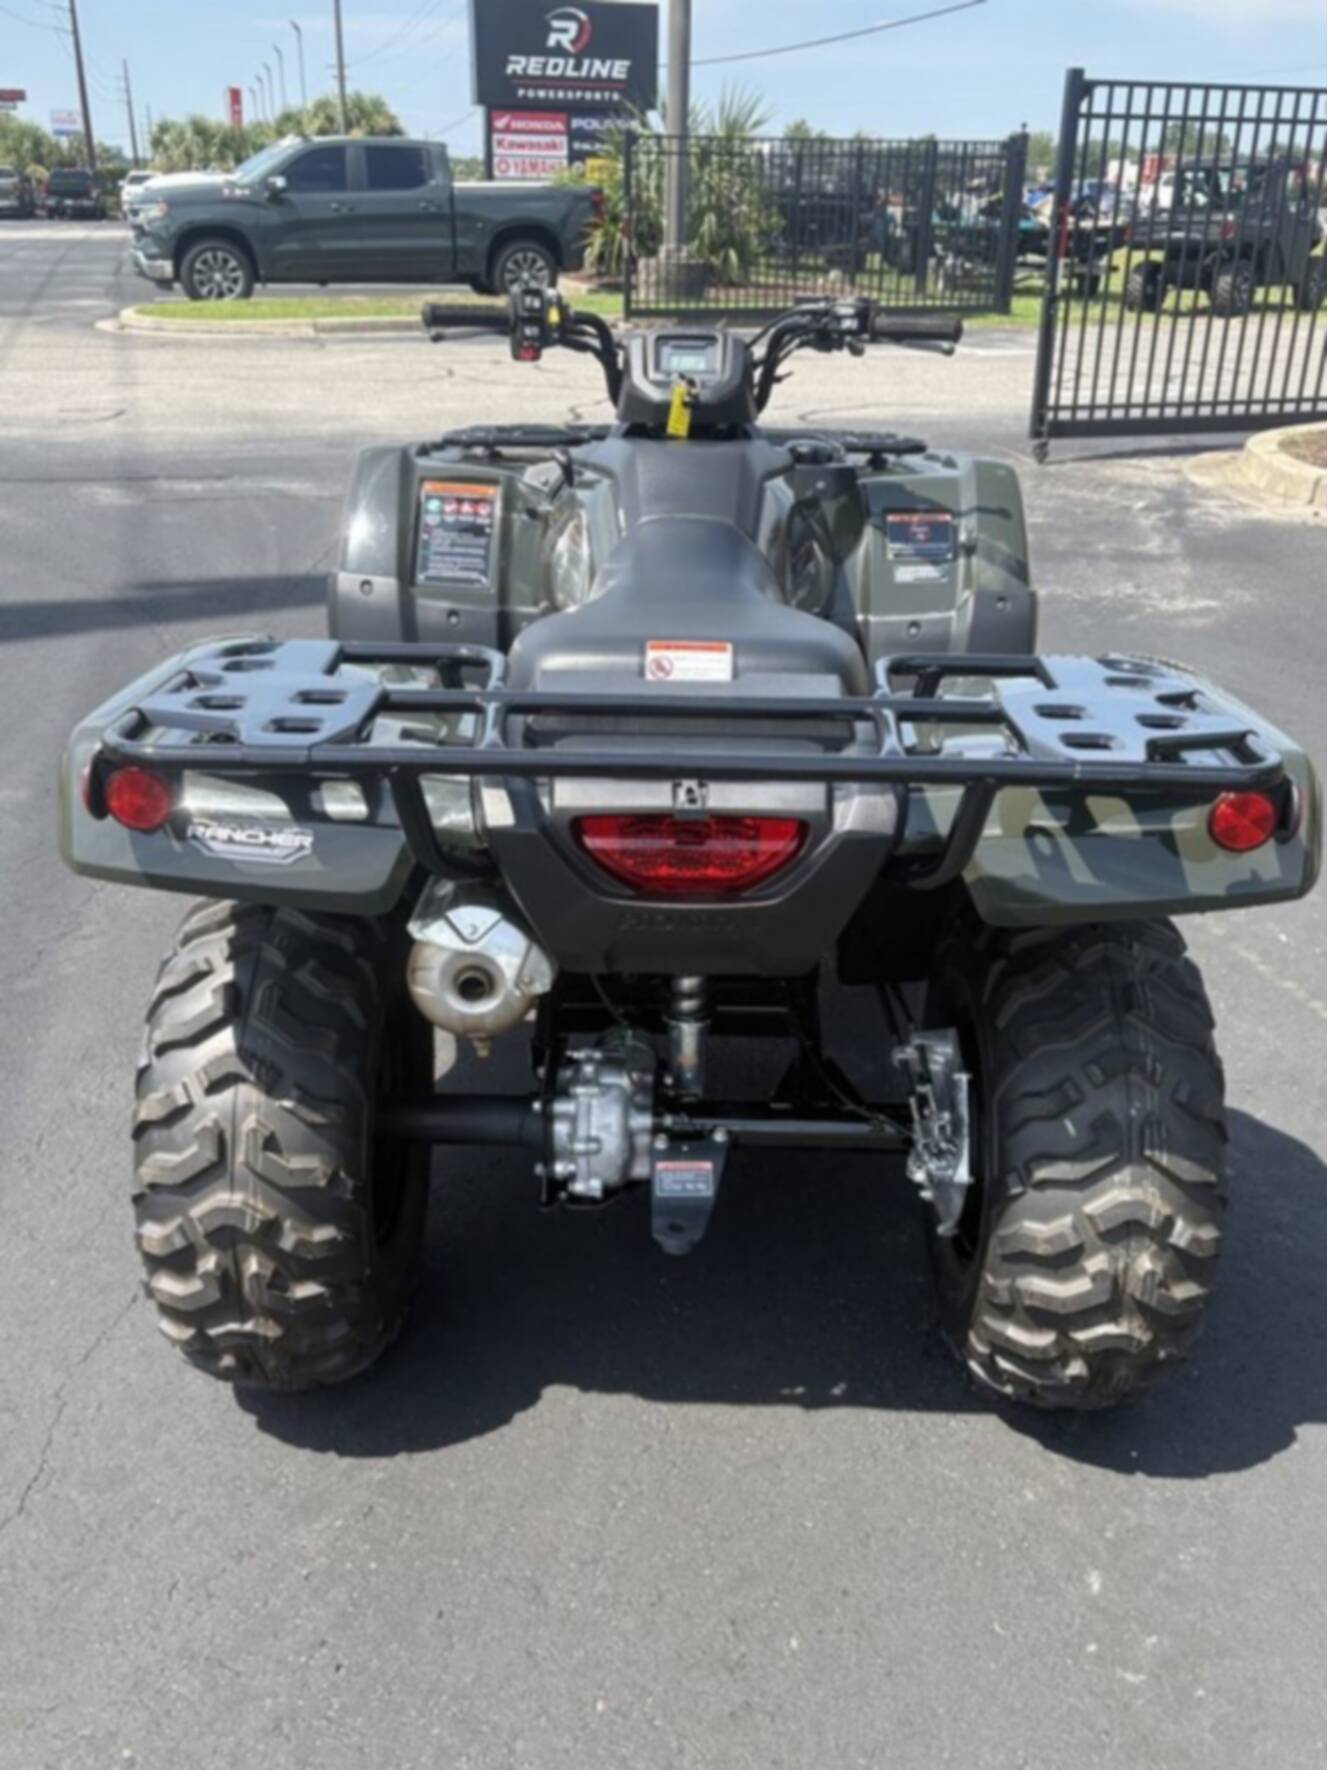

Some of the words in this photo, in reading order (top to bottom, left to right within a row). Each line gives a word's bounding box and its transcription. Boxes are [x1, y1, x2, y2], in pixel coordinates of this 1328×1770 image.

[506, 55, 631, 79] REDLINE
[517, 88, 620, 101] POWERSPORTS
[510, 119, 565, 131] HONDA
[496, 138, 564, 151] Kawasaki
